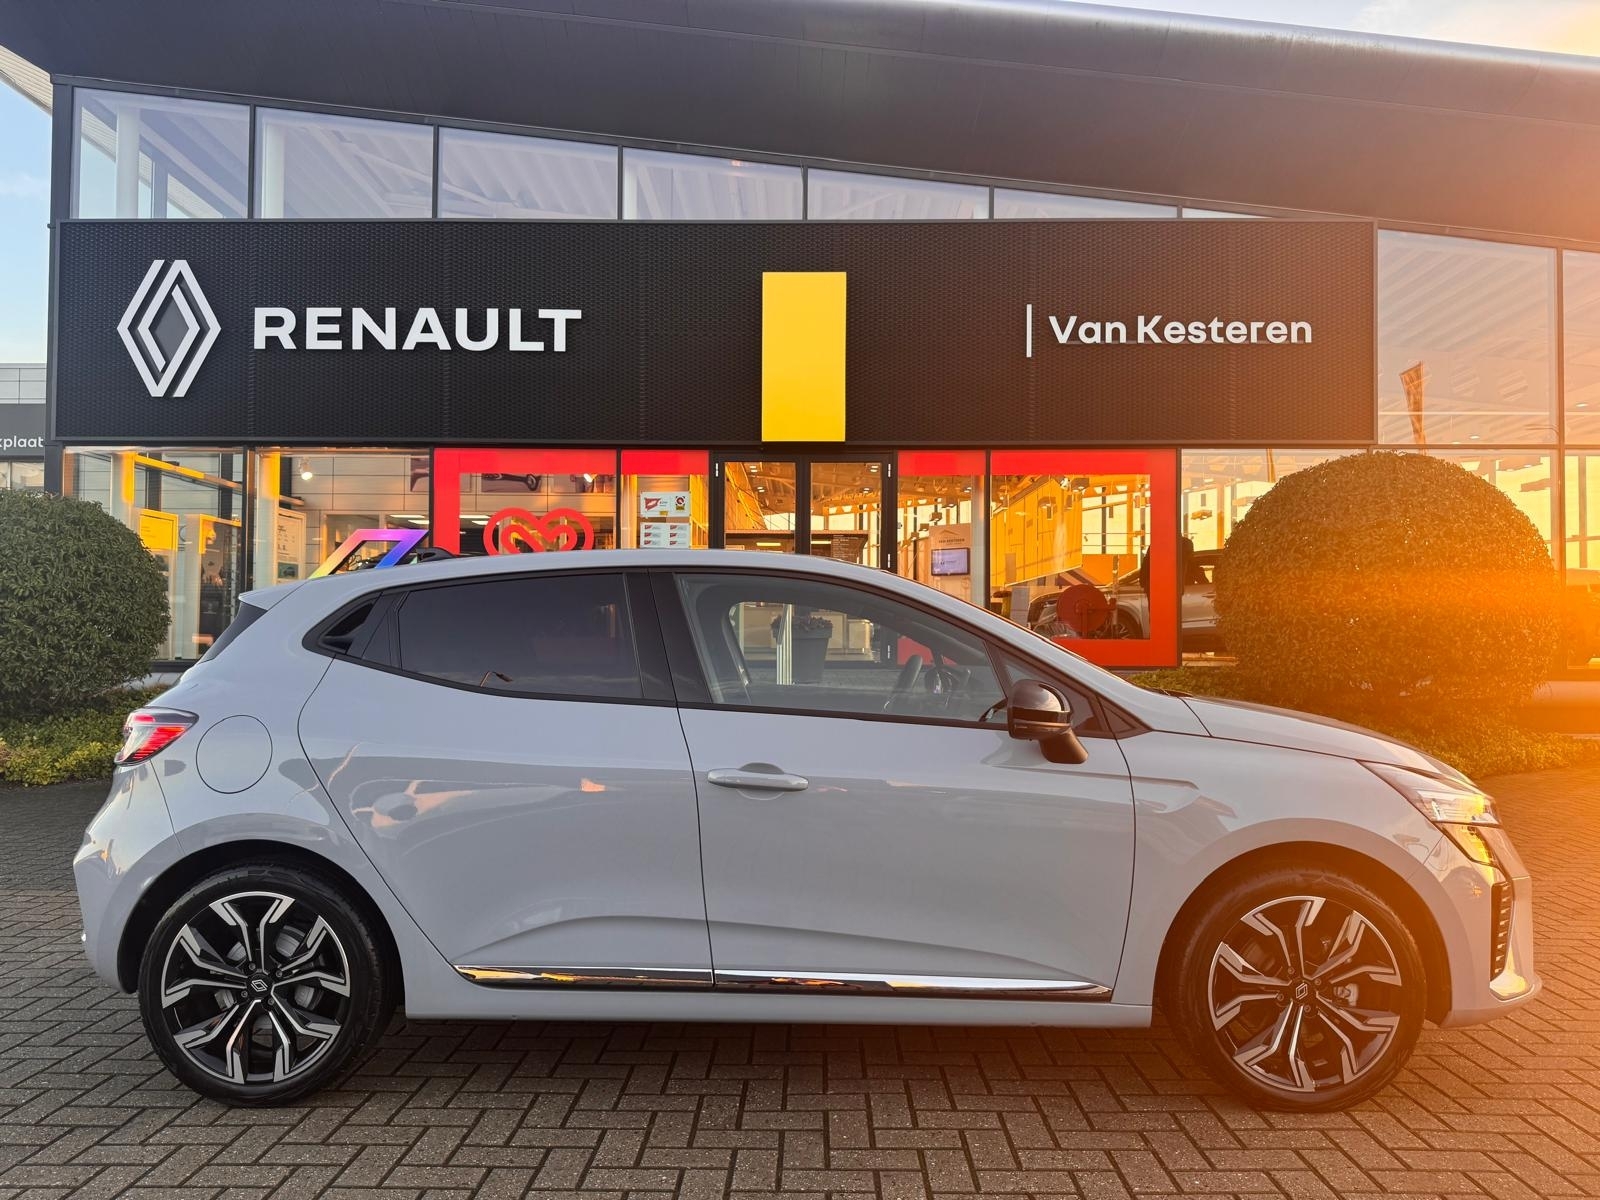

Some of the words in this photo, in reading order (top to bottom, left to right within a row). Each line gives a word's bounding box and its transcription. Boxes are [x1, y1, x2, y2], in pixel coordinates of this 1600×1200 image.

[253, 307, 582, 352] RENAULT
[1048, 315, 1127, 344] Van
[1137, 315, 1312, 344] Kesteren
[0, 435, 44, 451] plaat
